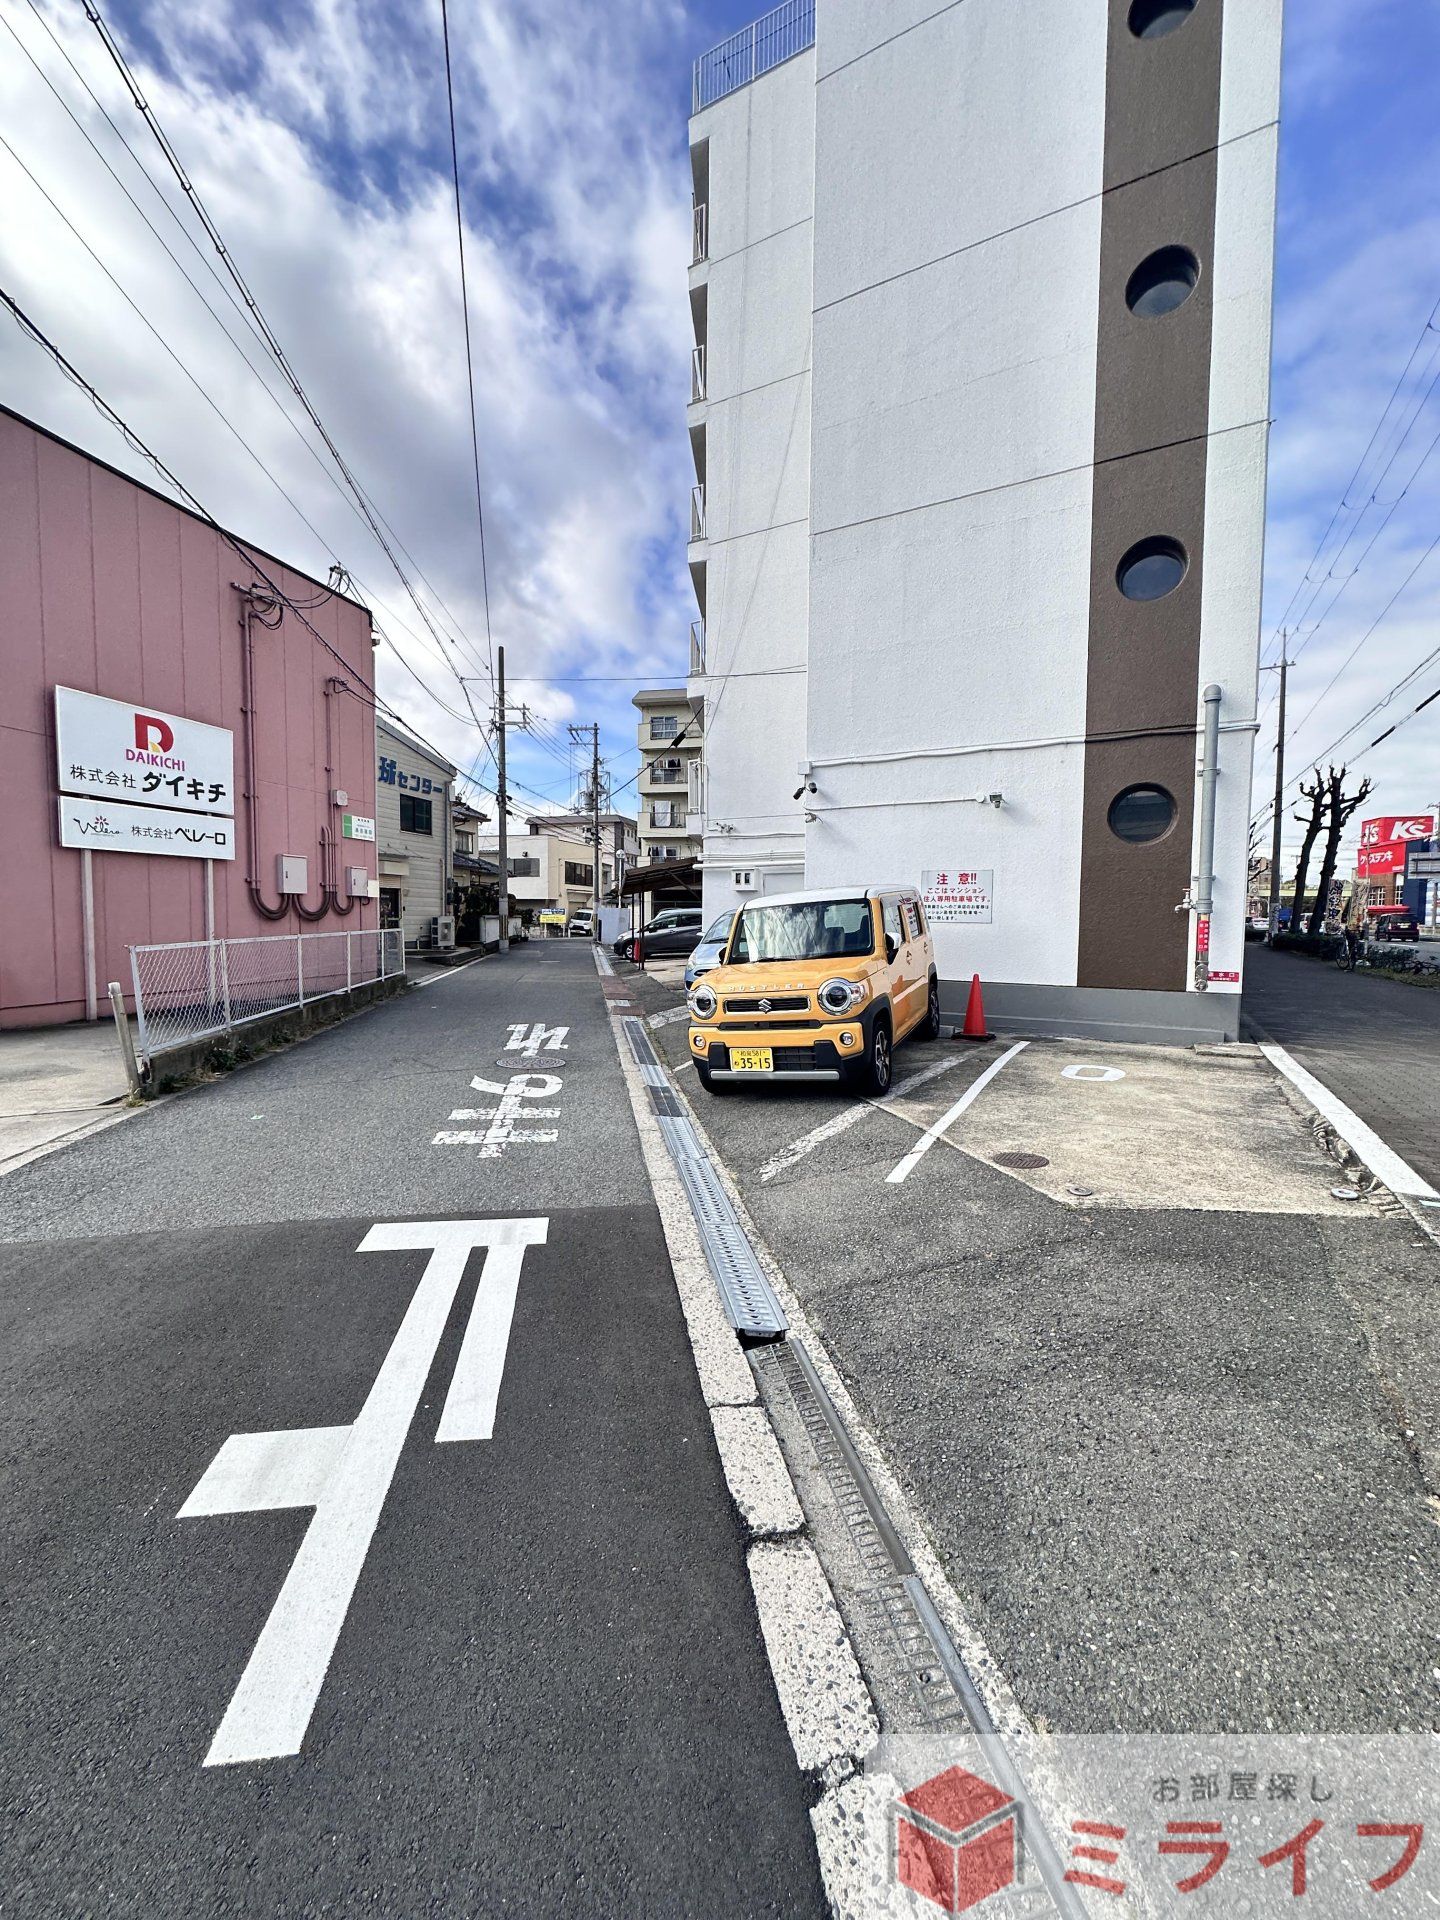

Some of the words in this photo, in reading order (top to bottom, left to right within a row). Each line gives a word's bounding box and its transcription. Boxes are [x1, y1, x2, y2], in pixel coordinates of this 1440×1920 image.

[126, 749, 185, 771] DAIKICHI
[1360, 851, 1393, 865] ケズデンキ
[740, 1057, 771, 1069] 35-15
